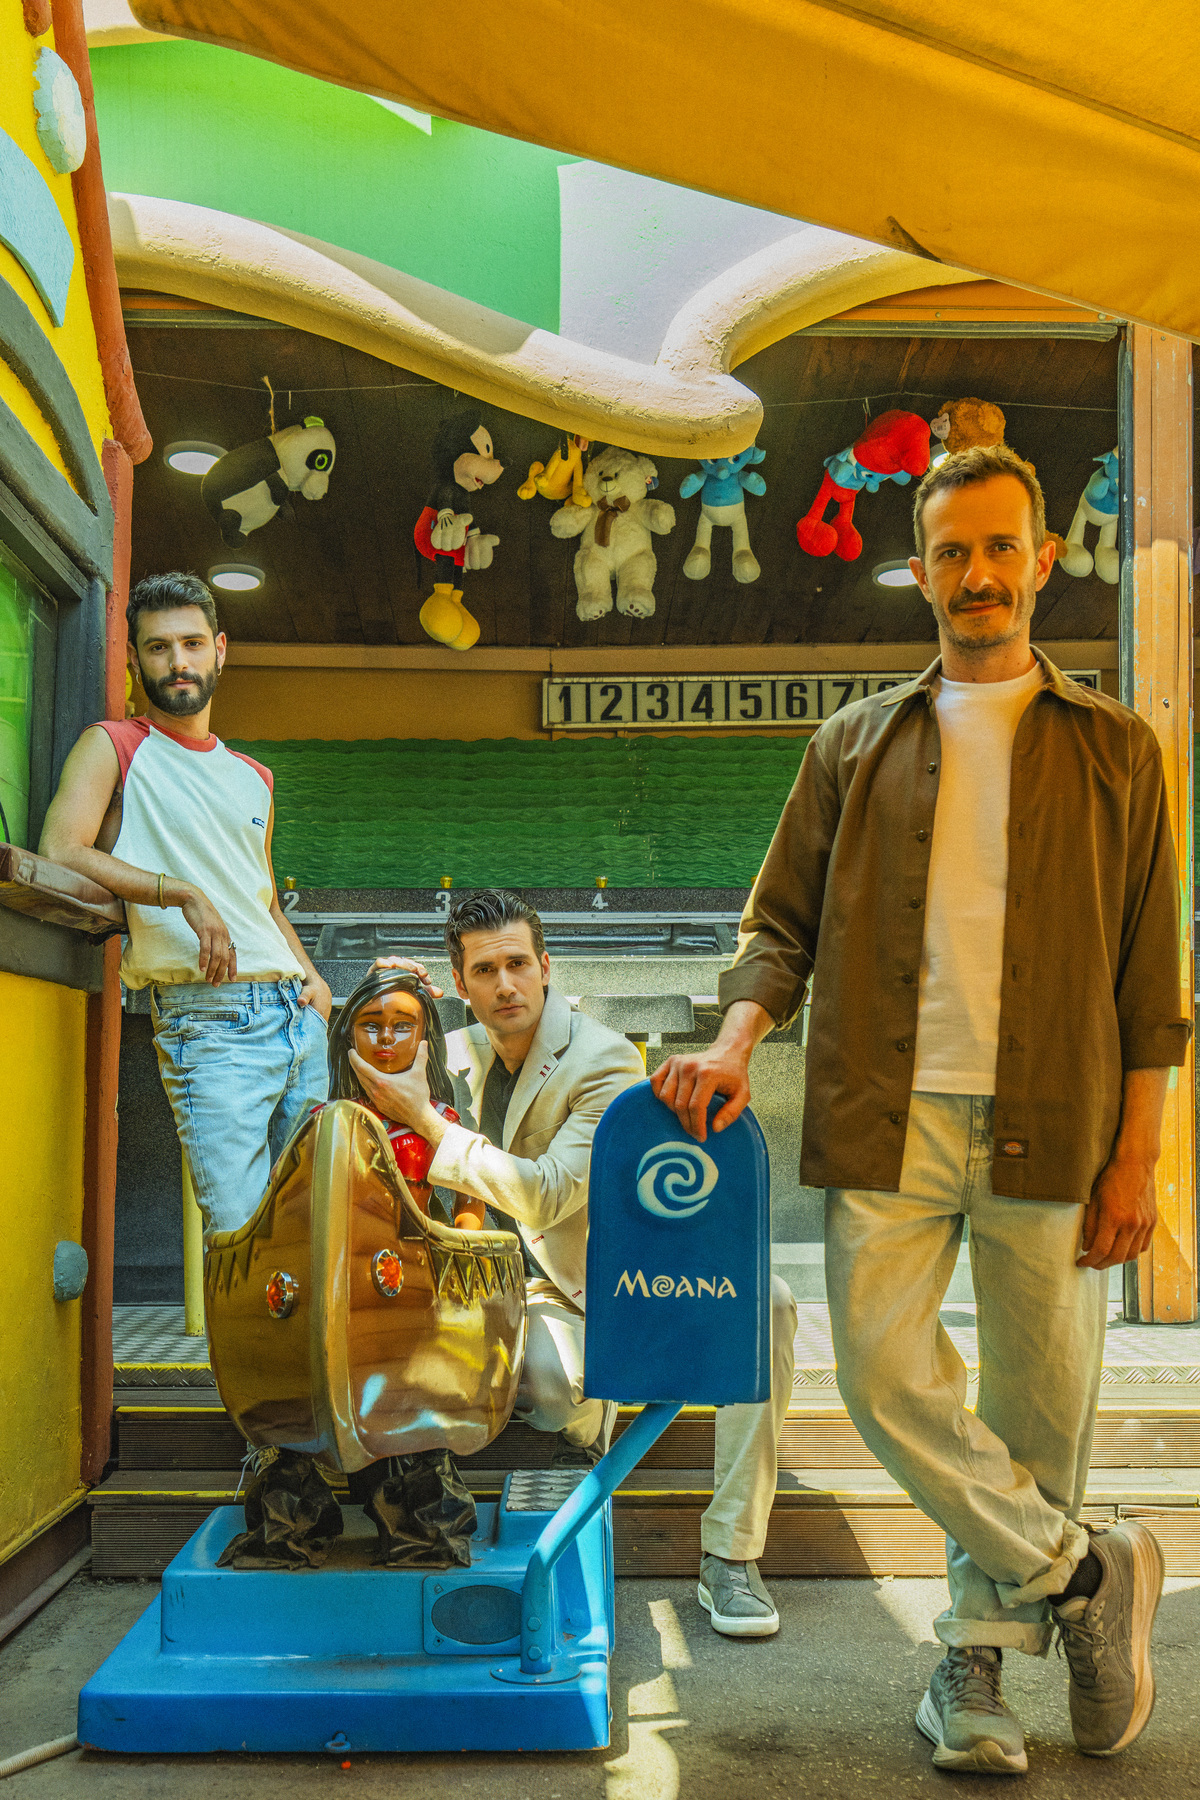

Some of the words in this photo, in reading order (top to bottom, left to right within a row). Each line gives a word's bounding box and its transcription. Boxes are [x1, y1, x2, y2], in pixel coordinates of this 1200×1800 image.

[558, 685, 572, 722] 1
[600, 684, 623, 721] 2
[646, 683, 669, 720] 3
[690, 683, 714, 720] 4
[739, 682, 763, 719] 5
[785, 682, 808, 718] 6
[832, 681, 855, 714] 7
[283, 891, 300, 913] 2
[435, 891, 451, 913] 3
[591, 892, 609, 910] 4
[613, 1269, 738, 1299] MOANA
